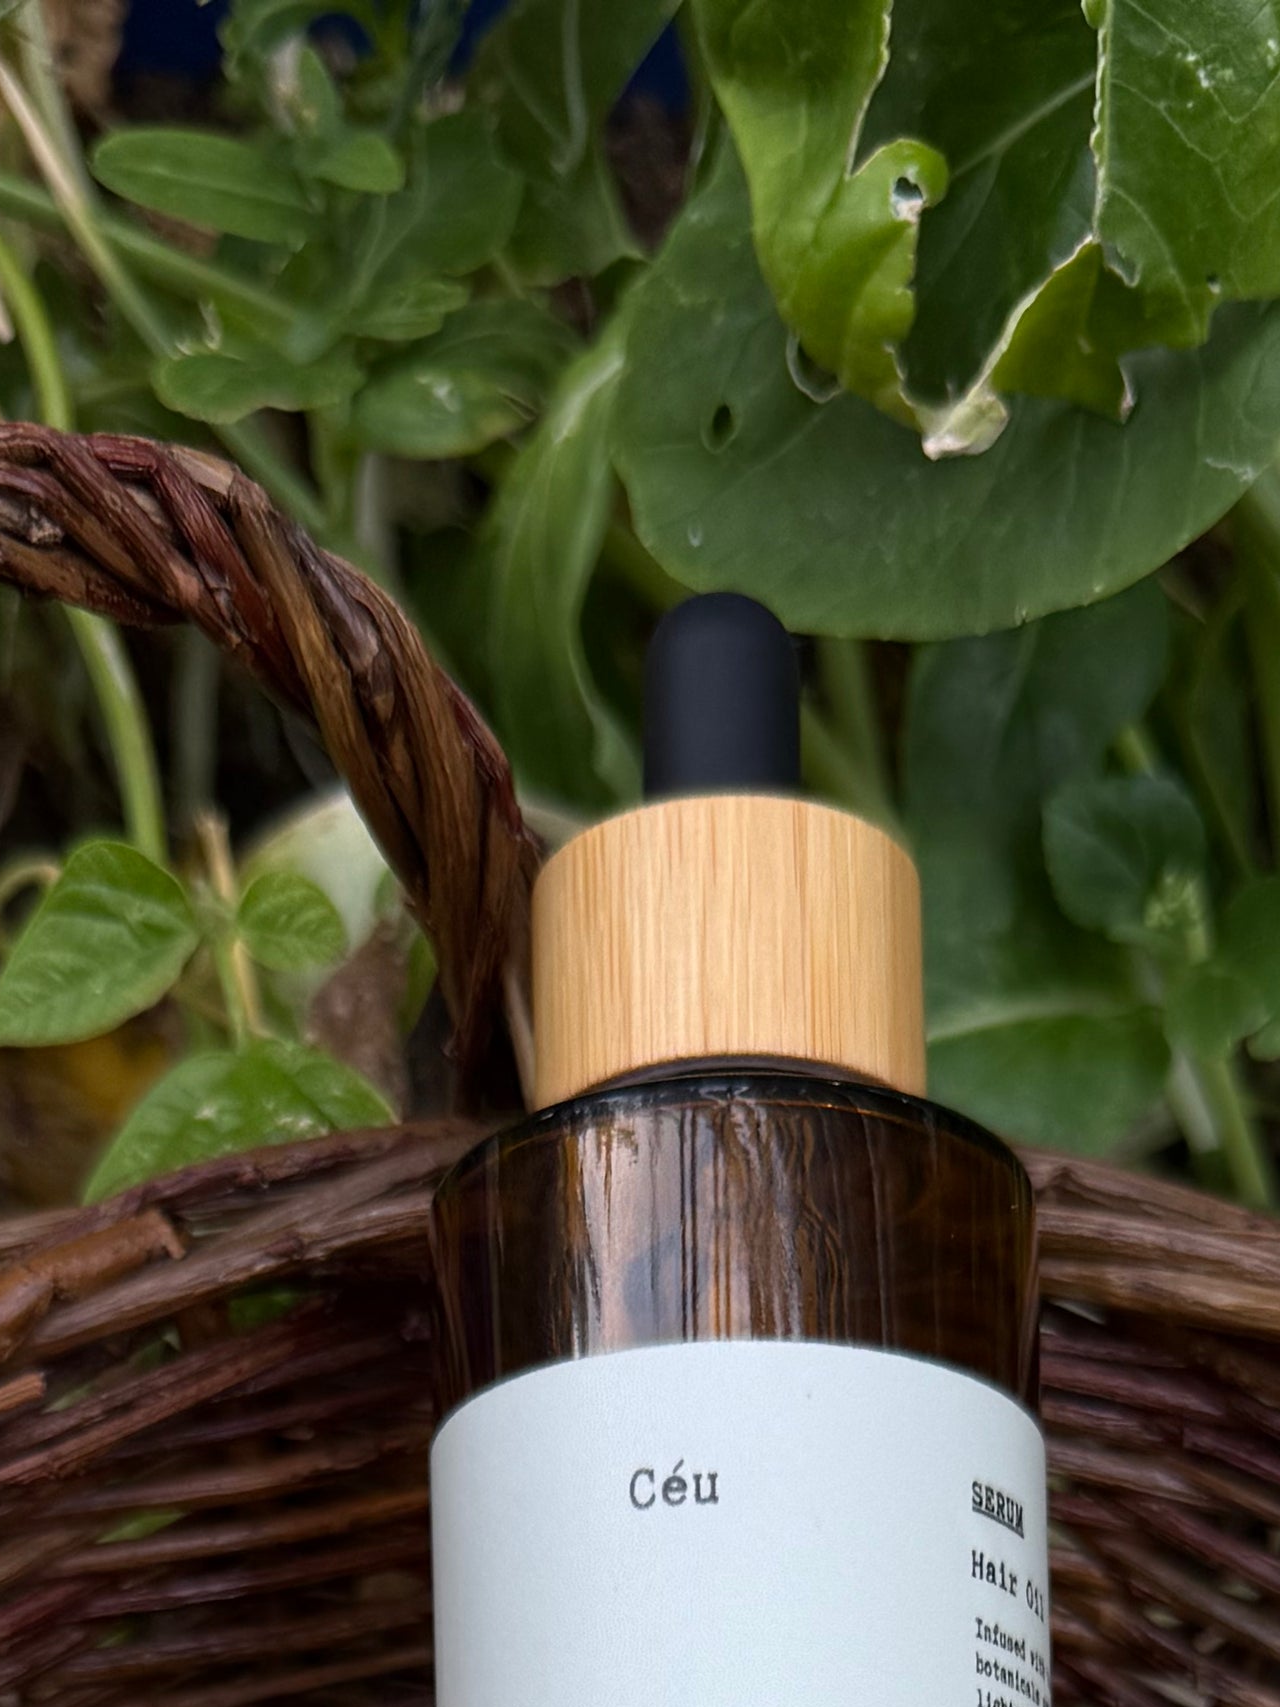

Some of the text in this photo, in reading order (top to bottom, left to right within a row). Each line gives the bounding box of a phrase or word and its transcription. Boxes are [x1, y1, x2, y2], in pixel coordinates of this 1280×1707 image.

[629, 1459, 719, 1510] Céu
[972, 1481, 1024, 1532] SERUM
[972, 1550, 1044, 1623] Hair Oil
[975, 1617, 1026, 1662] Infused
[976, 1651, 1040, 1706] botanicals
